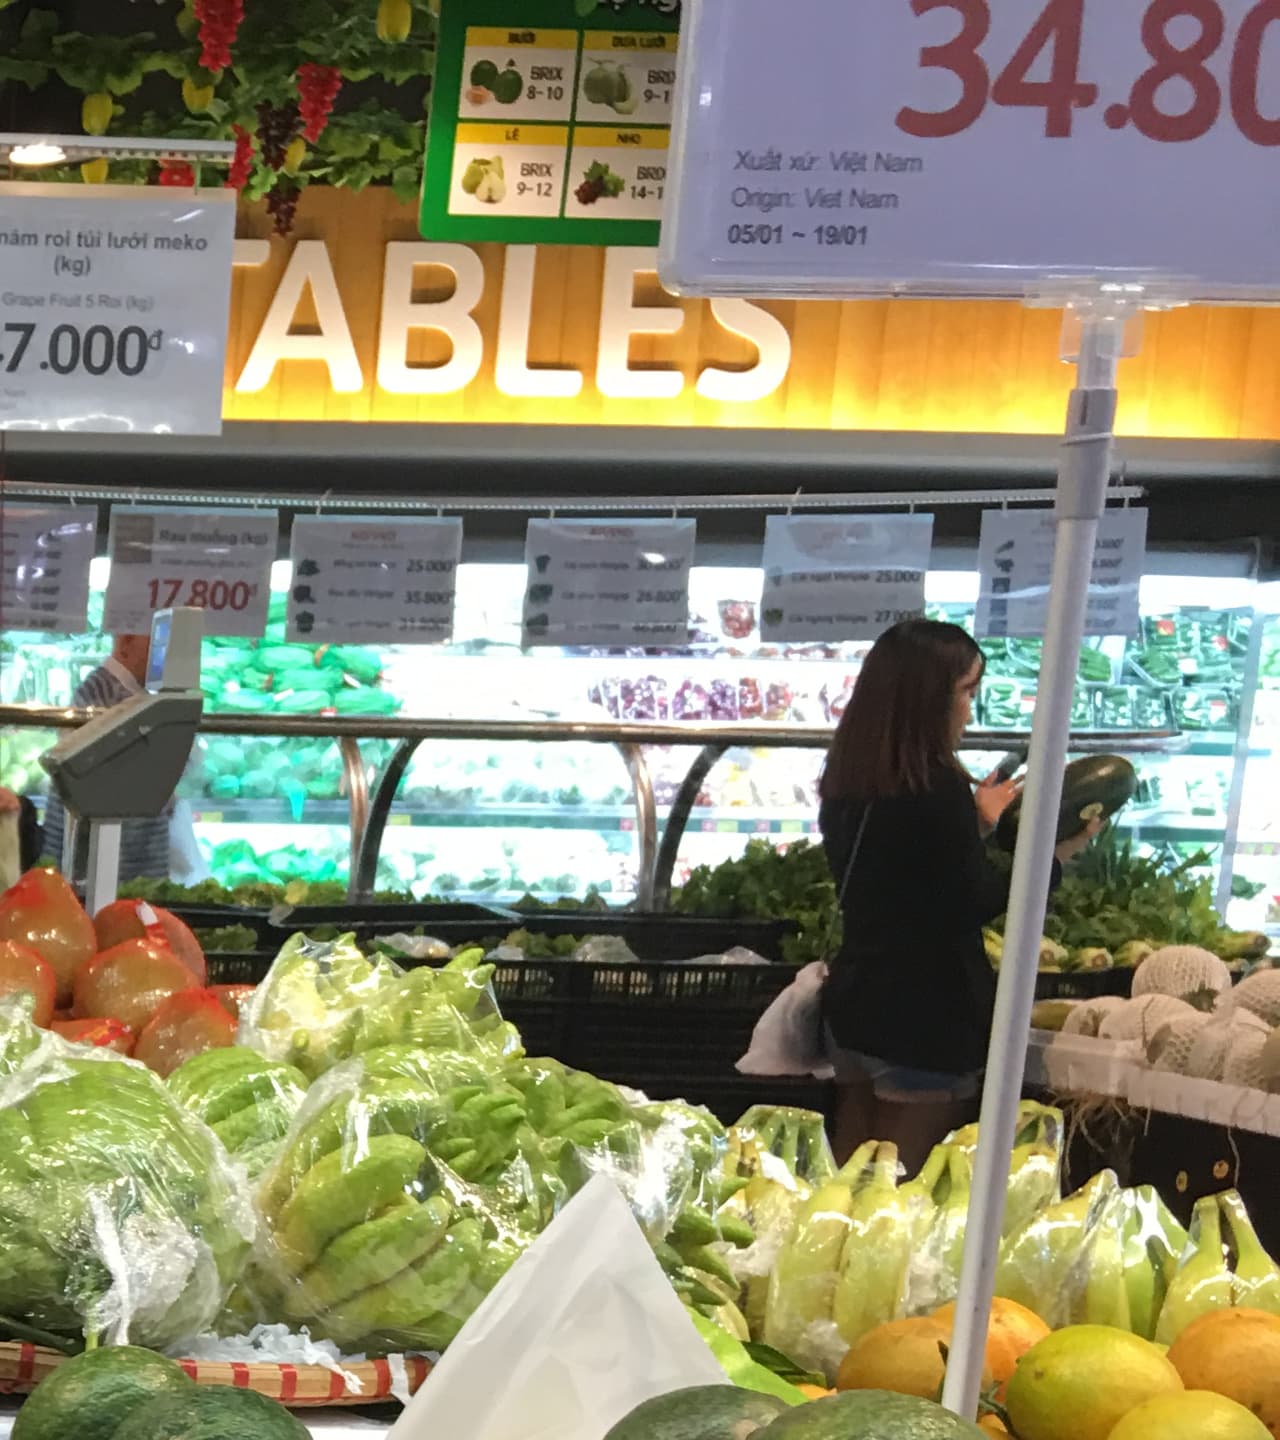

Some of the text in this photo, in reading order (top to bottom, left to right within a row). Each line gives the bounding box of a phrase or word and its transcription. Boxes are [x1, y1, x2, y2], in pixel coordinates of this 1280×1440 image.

[530, 66, 564, 81] BRIX
[520, 163, 553, 178] BRIX
[829, 151, 868, 174] Việt
[874, 152, 924, 173] Nam
[805, 188, 843, 209] Viet
[850, 188, 899, 209] Nam
[43, 230, 70, 248] roi
[153, 233, 209, 251] meko
[727, 223, 784, 245] 05/01
[813, 224, 869, 246] 19/01
[53, 254, 92, 278] (kg)
